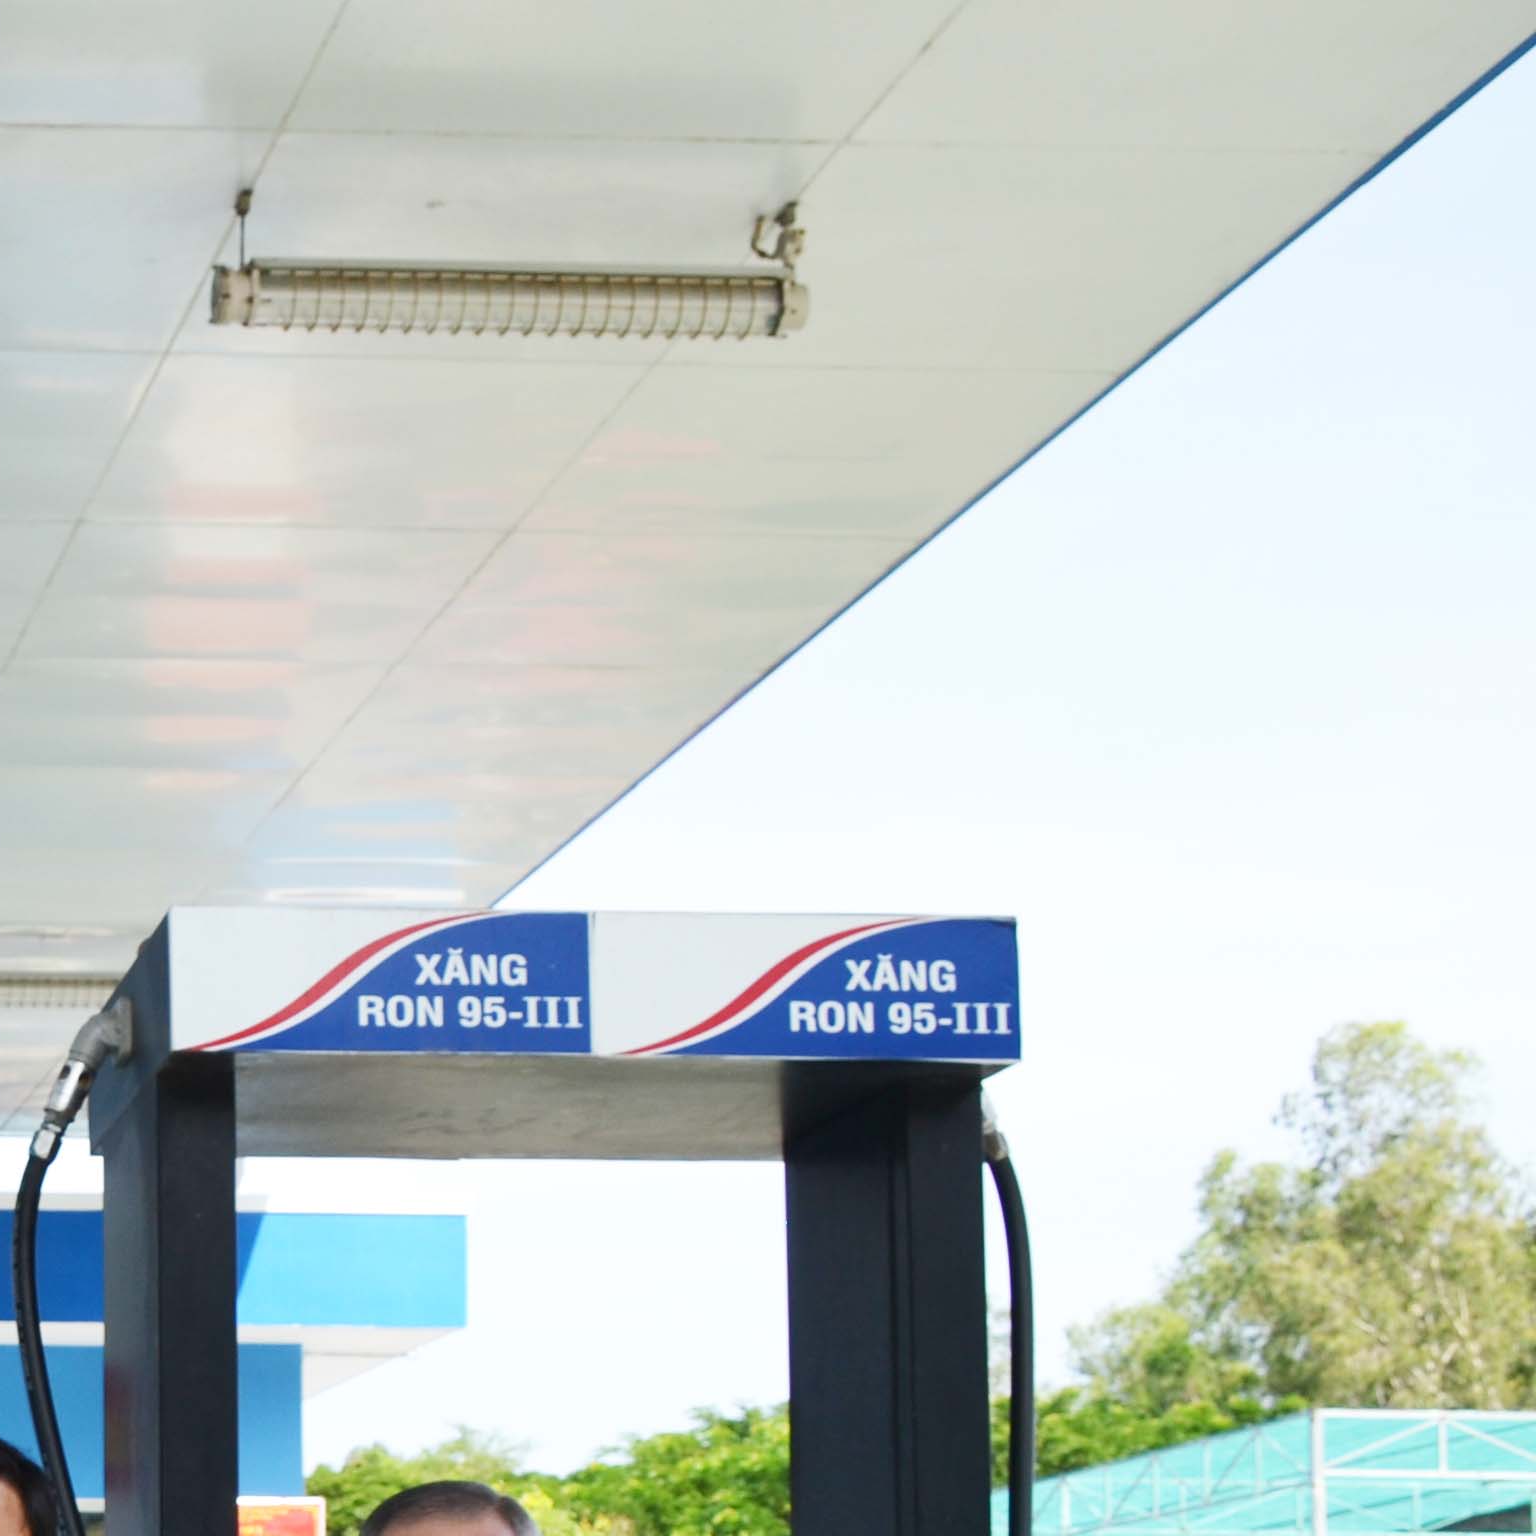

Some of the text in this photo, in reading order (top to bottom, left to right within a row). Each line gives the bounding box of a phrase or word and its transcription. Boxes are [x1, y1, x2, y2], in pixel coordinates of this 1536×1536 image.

[414, 947, 529, 987] XĂNG
[844, 953, 958, 993] XĂNG
[357, 995, 584, 1029] RON 95-III
[788, 1000, 1013, 1035] RON 95-III
